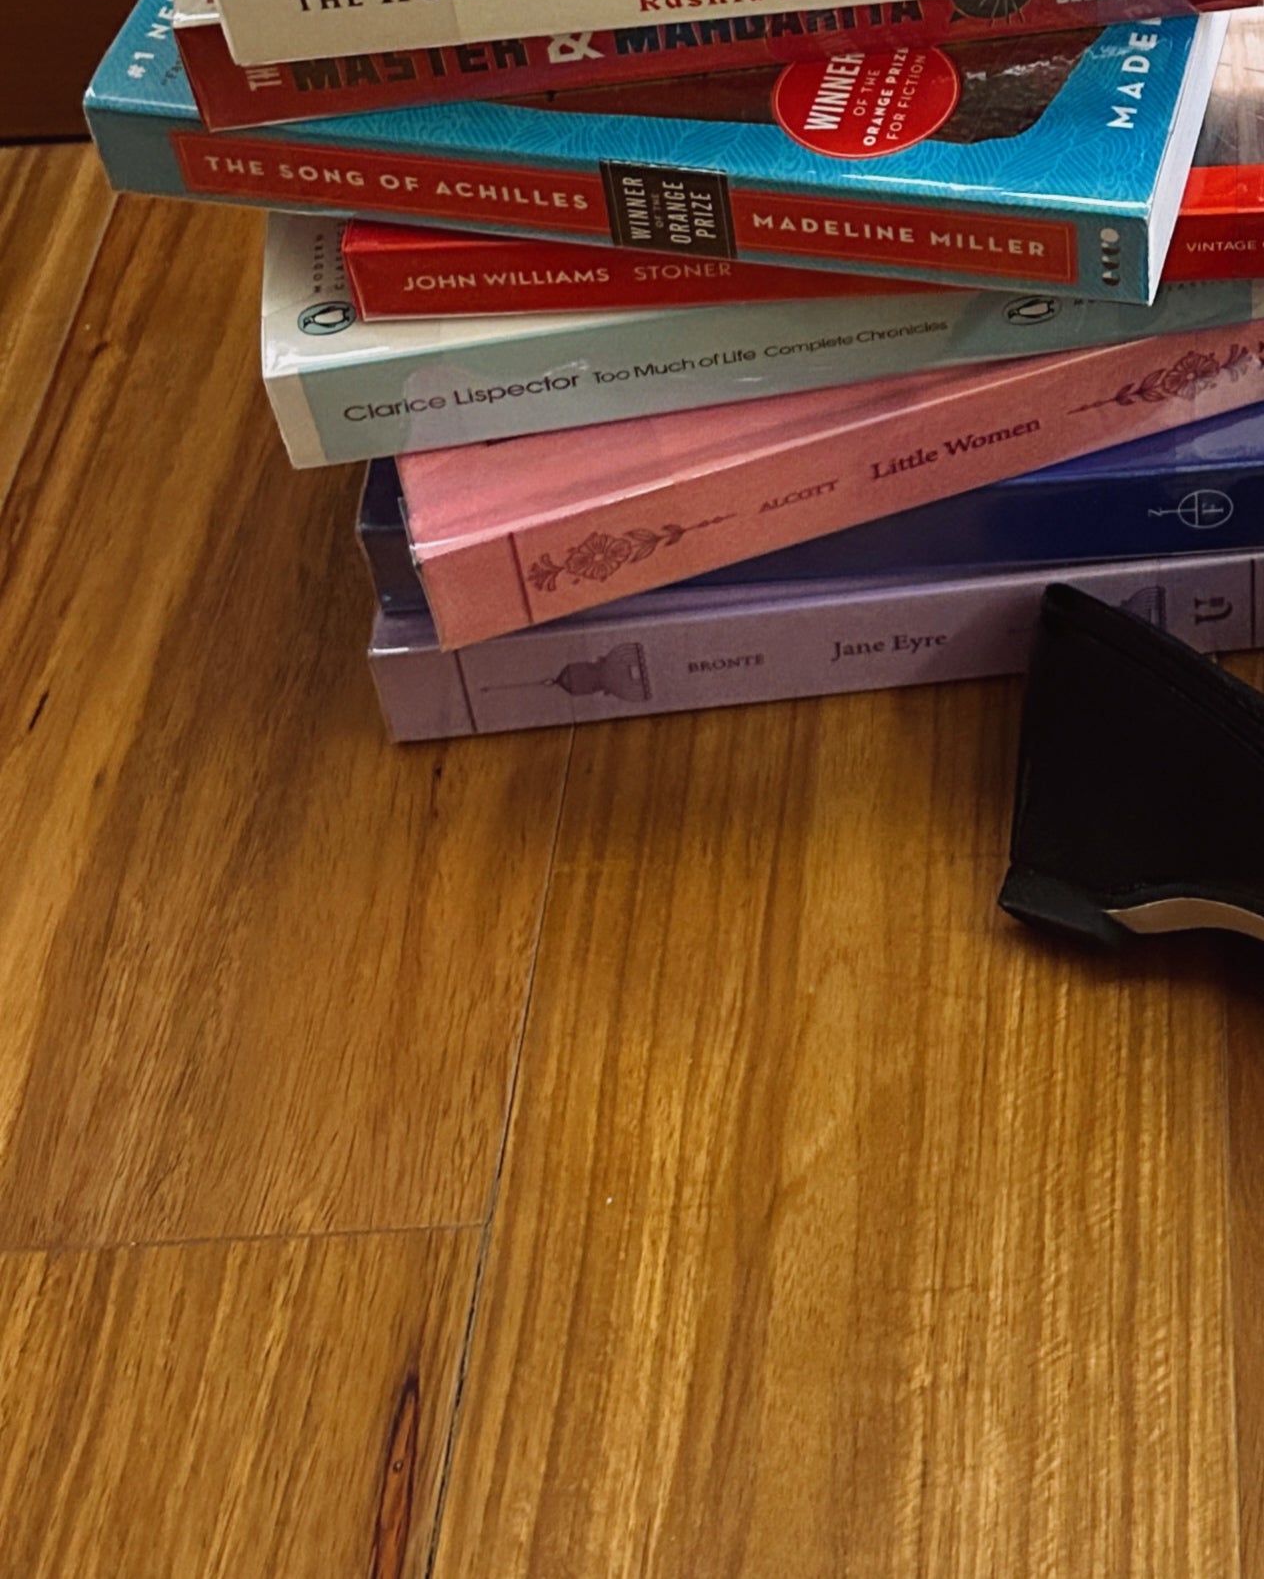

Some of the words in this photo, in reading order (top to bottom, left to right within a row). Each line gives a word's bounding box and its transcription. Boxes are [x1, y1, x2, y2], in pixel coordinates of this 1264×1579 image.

[803, 52, 866, 130] WINNER
[853, 98, 868, 117] OF
[860, 69, 880, 93] THE
[863, 88, 894, 147] ORANGE
[885, 46, 909, 84] PRIZE
[886, 113, 907, 140] FOR
[898, 54, 927, 108] FICTION
[204, 154, 265, 177] THE
[278, 163, 366, 189] SONG
[379, 173, 421, 192] OF
[435, 179, 590, 211] ACHILLES
[622, 176, 652, 240] WINNER
[662, 180, 693, 245] ORANGE
[689, 191, 717, 240] PRIZE
[752, 212, 916, 245] MADELINE
[929, 230, 1046, 259] MILLER
[403, 272, 476, 292] JOHN
[486, 267, 611, 286] WILLIAMS
[634, 262, 732, 281] STONER
[1186, 239, 1257, 253] VINTAGE
[344, 391, 446, 422] Clarice
[454, 370, 581, 407] Lispector
[592, 366, 631, 385] Too
[635, 356, 696, 378] Much
[697, 352, 721, 369] of
[722, 347, 757, 364] Life
[764, 333, 854, 360] Complete
[856, 319, 949, 342] Chronicles
[758, 479, 840, 515] ALCOTT
[869, 445, 940, 481] Little
[943, 417, 1041, 457] Women
[831, 636, 887, 662] Jane
[893, 630, 948, 652] Eyre
